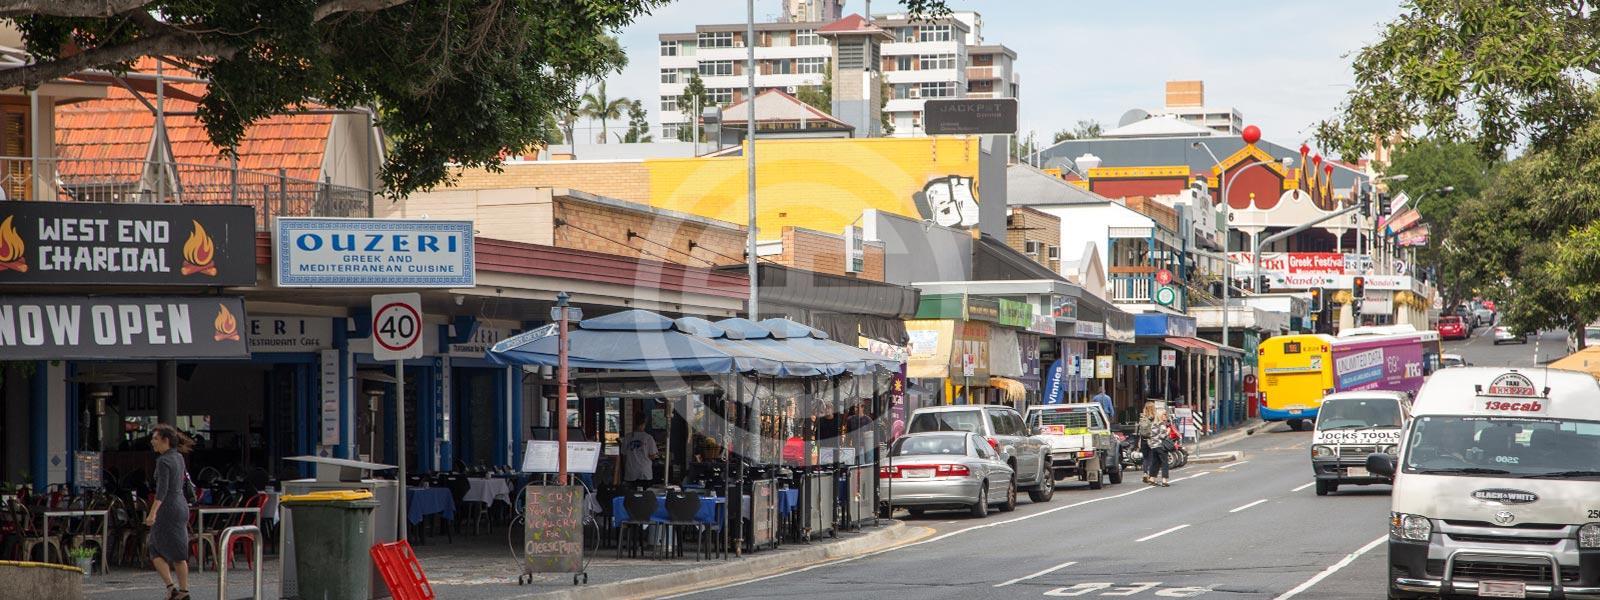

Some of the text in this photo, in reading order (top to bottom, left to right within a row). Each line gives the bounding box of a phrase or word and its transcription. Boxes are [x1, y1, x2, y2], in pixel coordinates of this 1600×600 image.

[38, 217, 170, 243] WEST END
[296, 233, 457, 253] OUZERI
[38, 245, 170, 273] CHARCOAL
[343, 254, 413, 263] GREEK AND
[1289, 256, 1313, 268] Greek
[1314, 256, 1343, 267] Festival
[299, 263, 455, 273] MEDITERRANEAN CUISINE
[1285, 276, 1326, 286] Nando's
[0, 303, 193, 346] NOW OPEN
[251, 319, 306, 336] ERI
[379, 315, 415, 339] 40
[1048, 366, 1063, 404] Vinnies
[1485, 400, 1542, 412] 13ecab
[1318, 431, 1401, 440] JOCKS TOOLS
